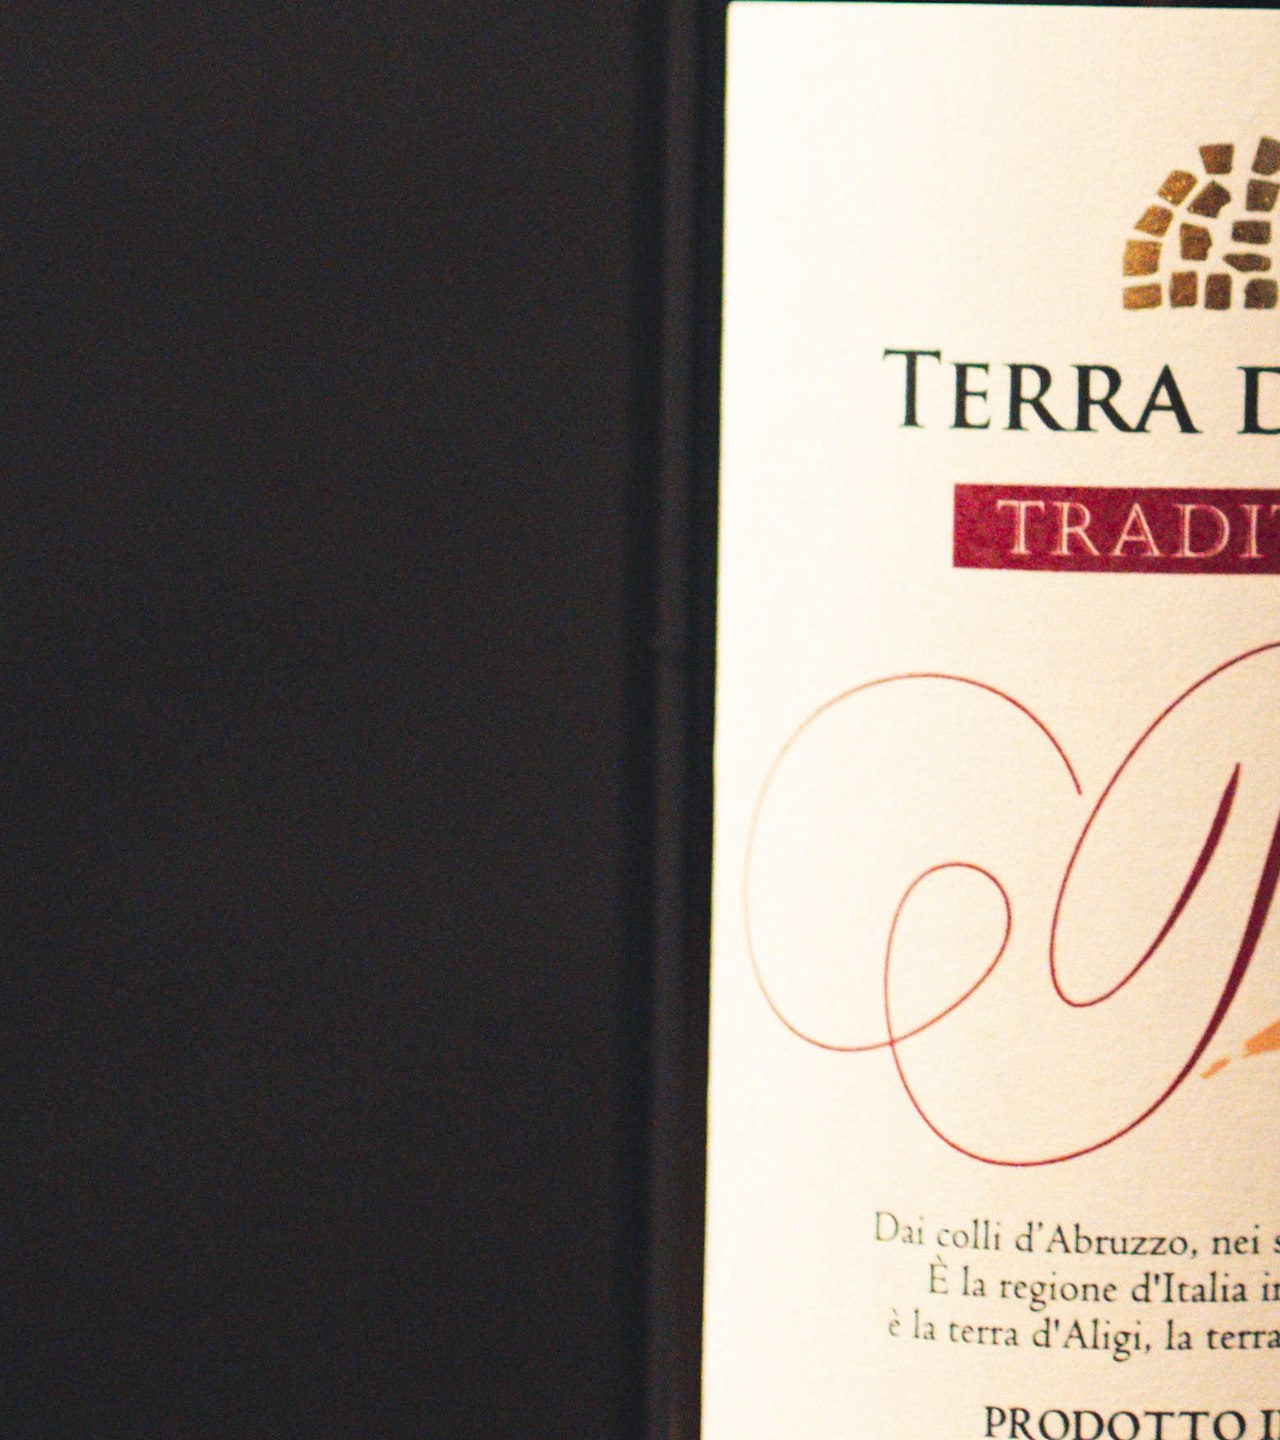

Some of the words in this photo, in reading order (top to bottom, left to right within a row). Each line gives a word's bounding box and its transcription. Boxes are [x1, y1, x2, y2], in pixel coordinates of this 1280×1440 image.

[874, 1210, 925, 1246] Dai
[936, 1218, 1001, 1251] colli
[1211, 1223, 1261, 1256] nei
[928, 1254, 950, 1295] È
[961, 1265, 987, 1299] la
[999, 1271, 1117, 1313] regione
[912, 1308, 937, 1341] la
[948, 1320, 1020, 1347] terra
[1165, 1319, 1193, 1351] la
